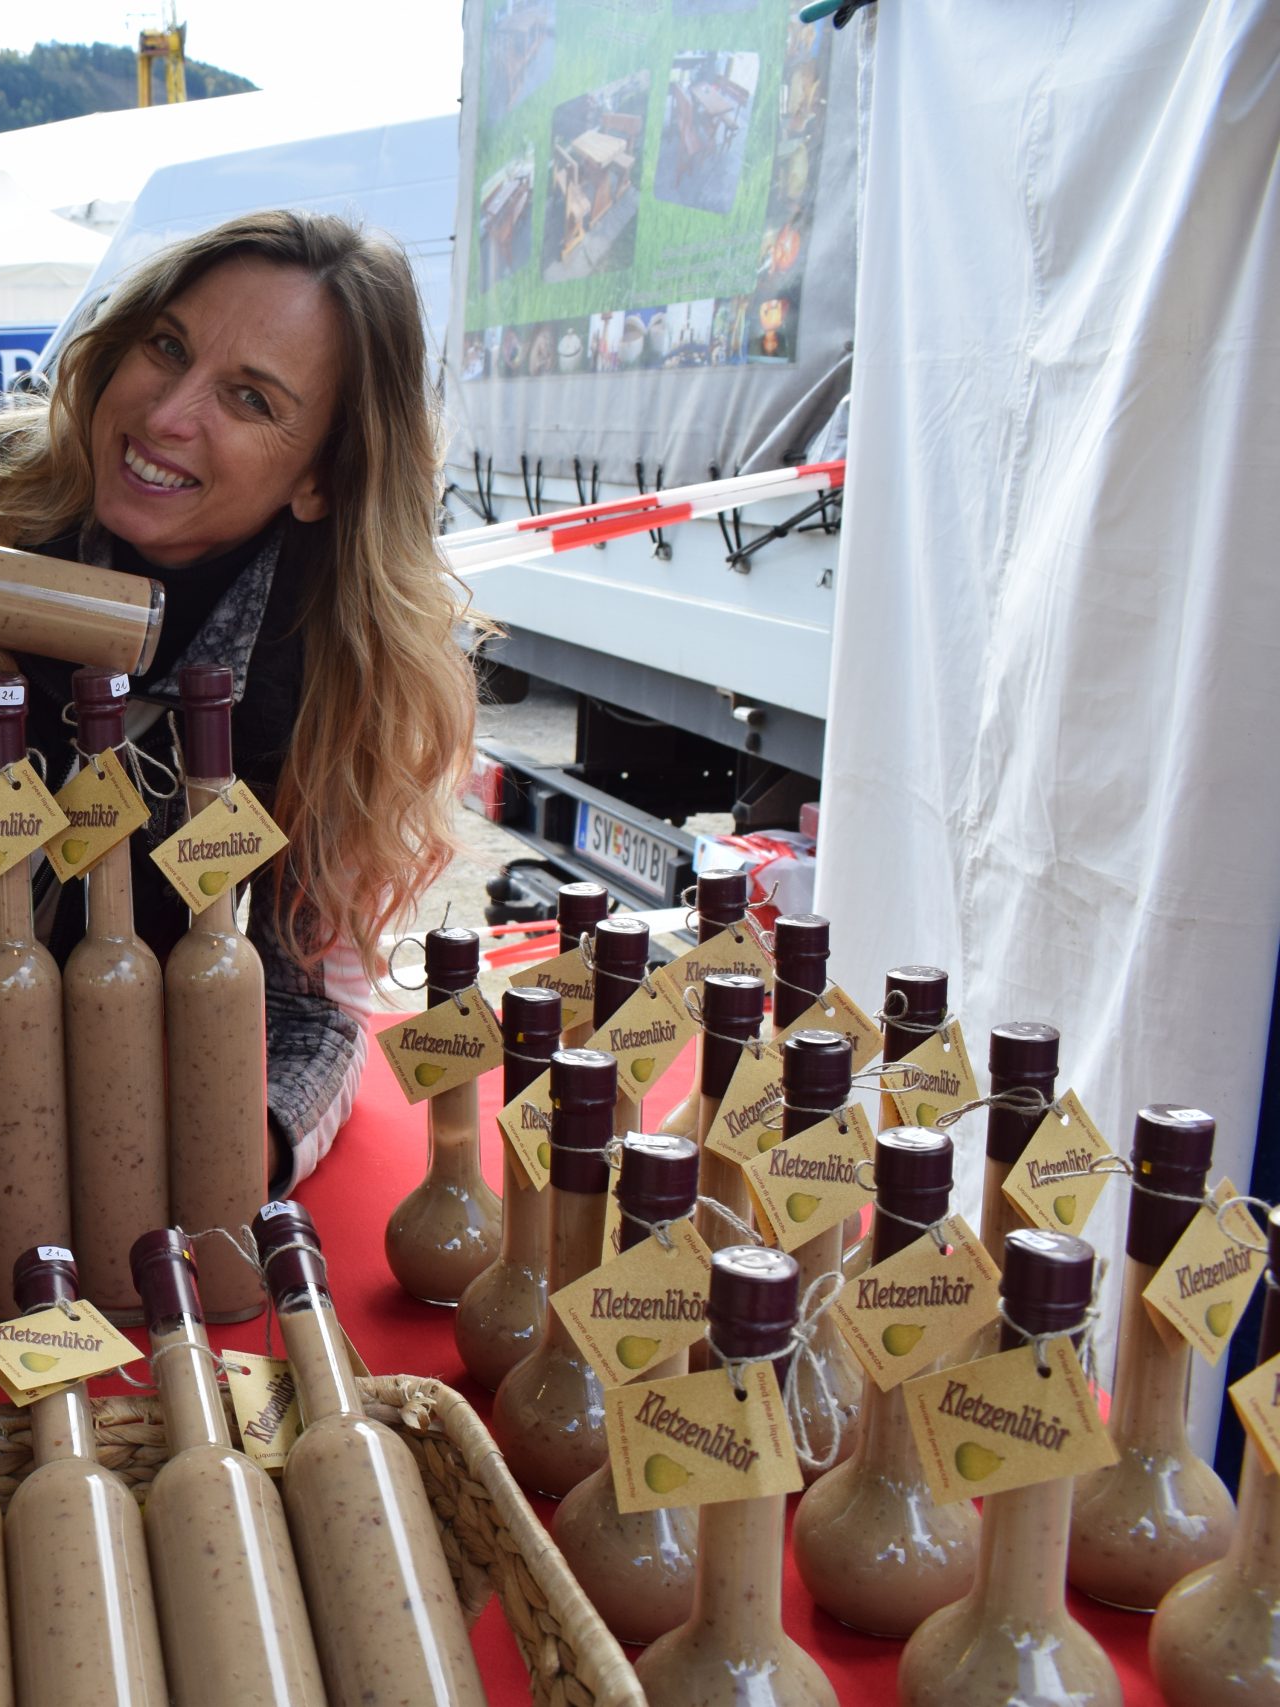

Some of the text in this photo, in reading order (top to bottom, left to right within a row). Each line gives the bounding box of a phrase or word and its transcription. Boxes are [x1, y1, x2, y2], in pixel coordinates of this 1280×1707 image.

[65, 804, 119, 828] tzenlikör
[178, 832, 262, 863] Kletzenlikör
[536, 974, 595, 1000] Kletzenli
[400, 1027, 485, 1058] Kletzenlikör
[609, 1020, 677, 1052] Kletzenlikör
[683, 1234, 711, 1271] Dried pear
[948, 1220, 992, 1281] Dried pear liqueur
[1176, 1245, 1252, 1299] Kletzenlikör
[856, 1275, 975, 1310] Kletzenlikör
[569, 1308, 587, 1336] Liquore
[589, 1341, 602, 1359] pere
[600, 1357, 618, 1382] secche
[835, 1302, 854, 1326] Liquore
[856, 1332, 868, 1349] pere
[867, 1347, 884, 1371] secche
[243, 1372, 295, 1444] Kletzenlikö
[635, 1390, 760, 1473] Kletzenlikör
[757, 1371, 783, 1457] Dried pear liqueur
[938, 1379, 1071, 1452] Kletzenlikör
